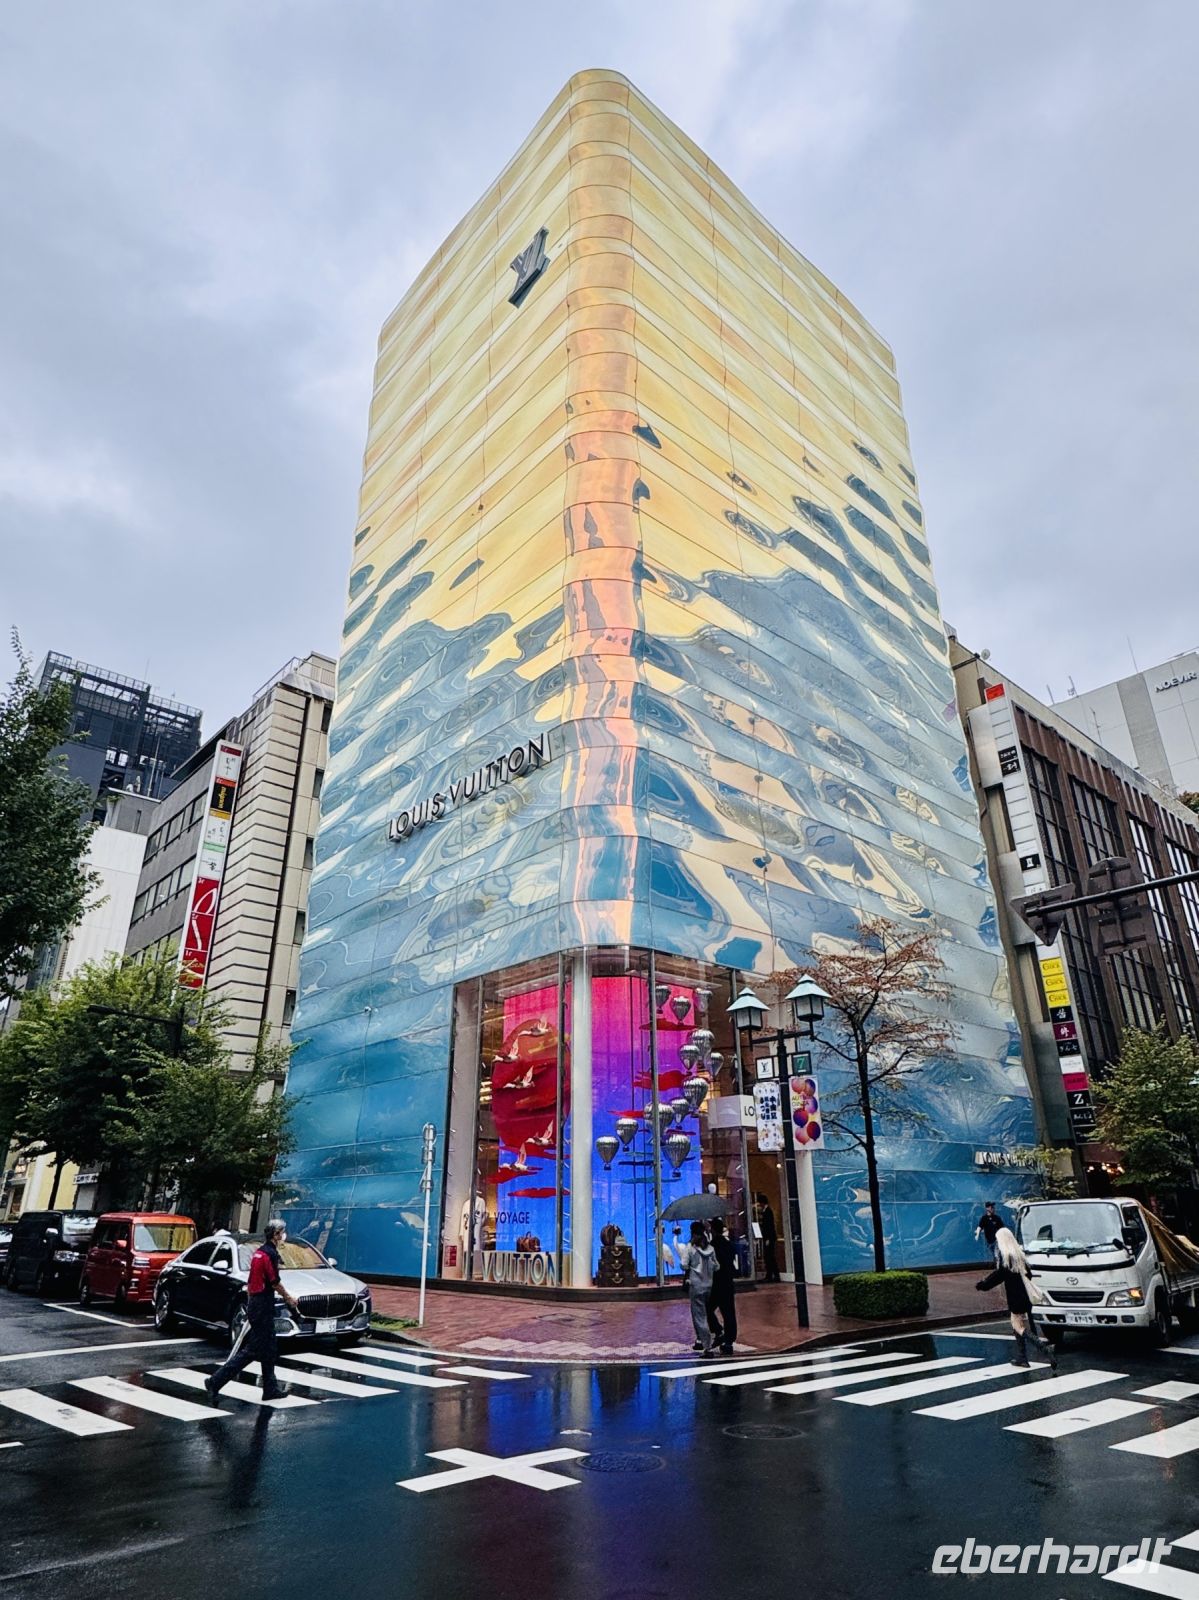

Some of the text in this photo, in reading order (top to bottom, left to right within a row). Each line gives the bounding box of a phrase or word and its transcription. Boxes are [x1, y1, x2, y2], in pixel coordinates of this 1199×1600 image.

[388, 732, 552, 842] LOUIS VUITTON
[1073, 1093, 1084, 1105] Z
[495, 1211, 530, 1225] VOYAGE
